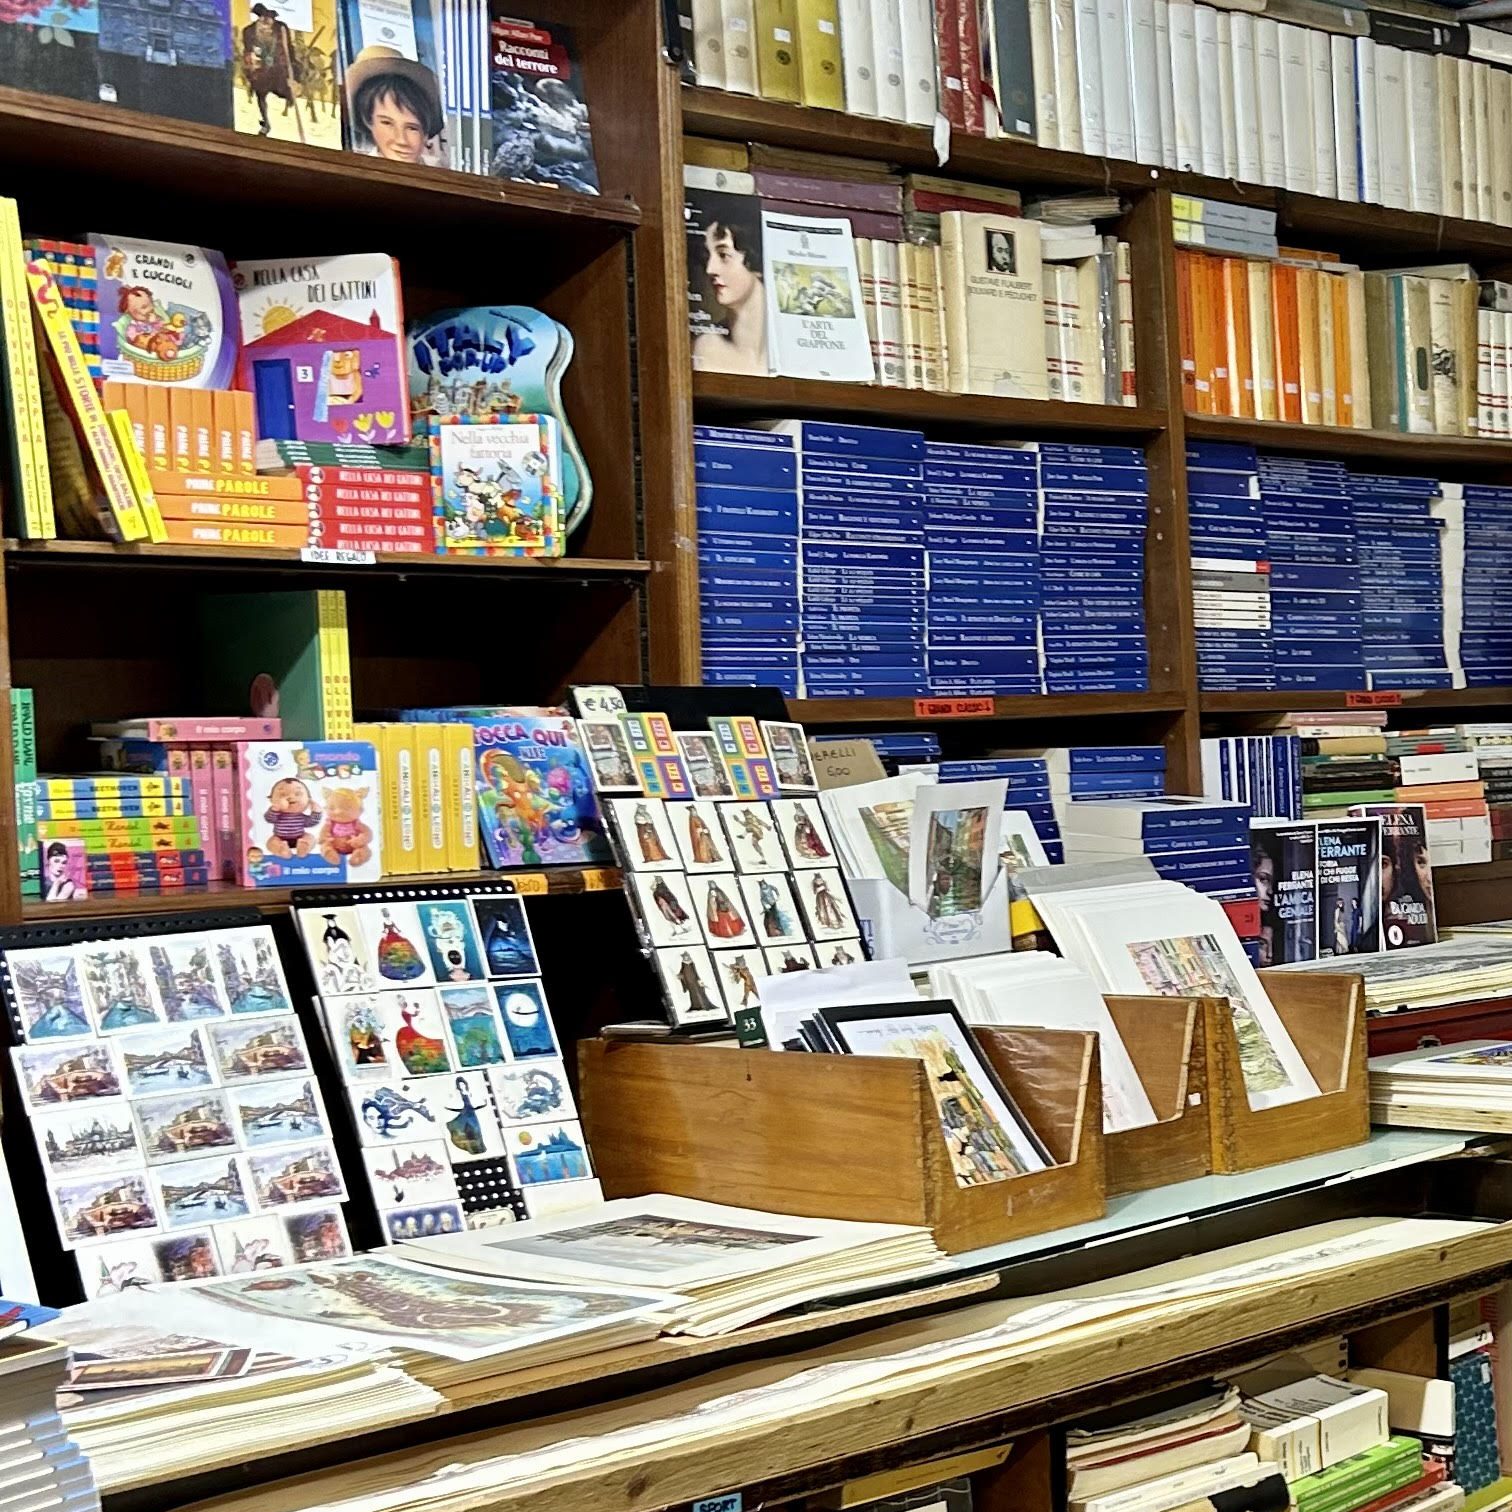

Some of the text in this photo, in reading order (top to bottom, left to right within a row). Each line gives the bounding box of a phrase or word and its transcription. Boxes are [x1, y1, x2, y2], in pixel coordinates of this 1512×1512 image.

[498, 40, 549, 60] Racconti
[494, 53, 558, 75] del terrore
[135, 254, 174, 270] GRANDI
[142, 270, 193, 291] CUCCIOLI
[253, 264, 319, 287] NELLA CASA
[307, 280, 377, 304] DEI GATTINI
[797, 338, 846, 351] GIAPPONE
[300, 368, 309, 381] 3
[452, 432, 529, 445] Nella vecchia
[215, 479, 269, 494] PAROLE
[221, 504, 275, 518] PAROLE
[221, 529, 275, 542] PAROLE
[531, 728, 569, 747] QUI
